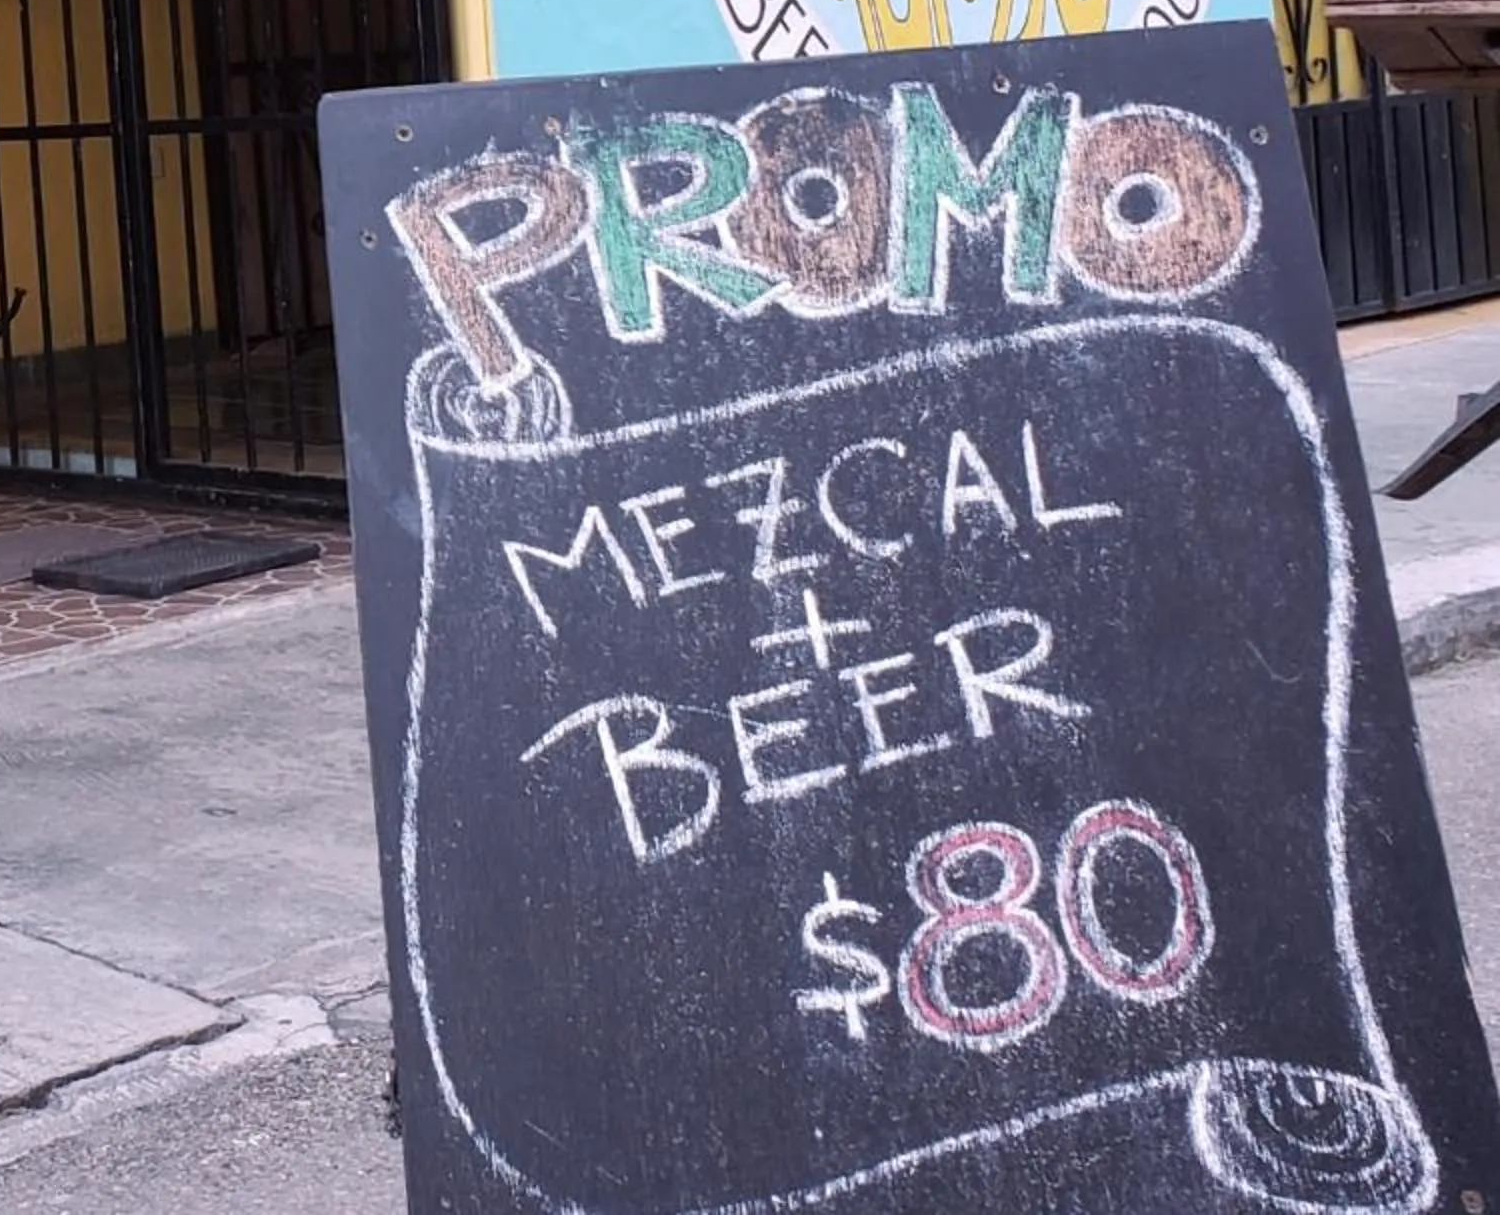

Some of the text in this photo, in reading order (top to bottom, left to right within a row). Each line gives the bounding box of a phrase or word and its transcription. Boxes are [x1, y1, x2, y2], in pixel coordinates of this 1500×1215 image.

[385, 80, 1262, 385] PROMO
[502, 420, 1122, 639] MEZCAL
[519, 606, 1094, 865] BEER
[795, 797, 1215, 1053] $80
